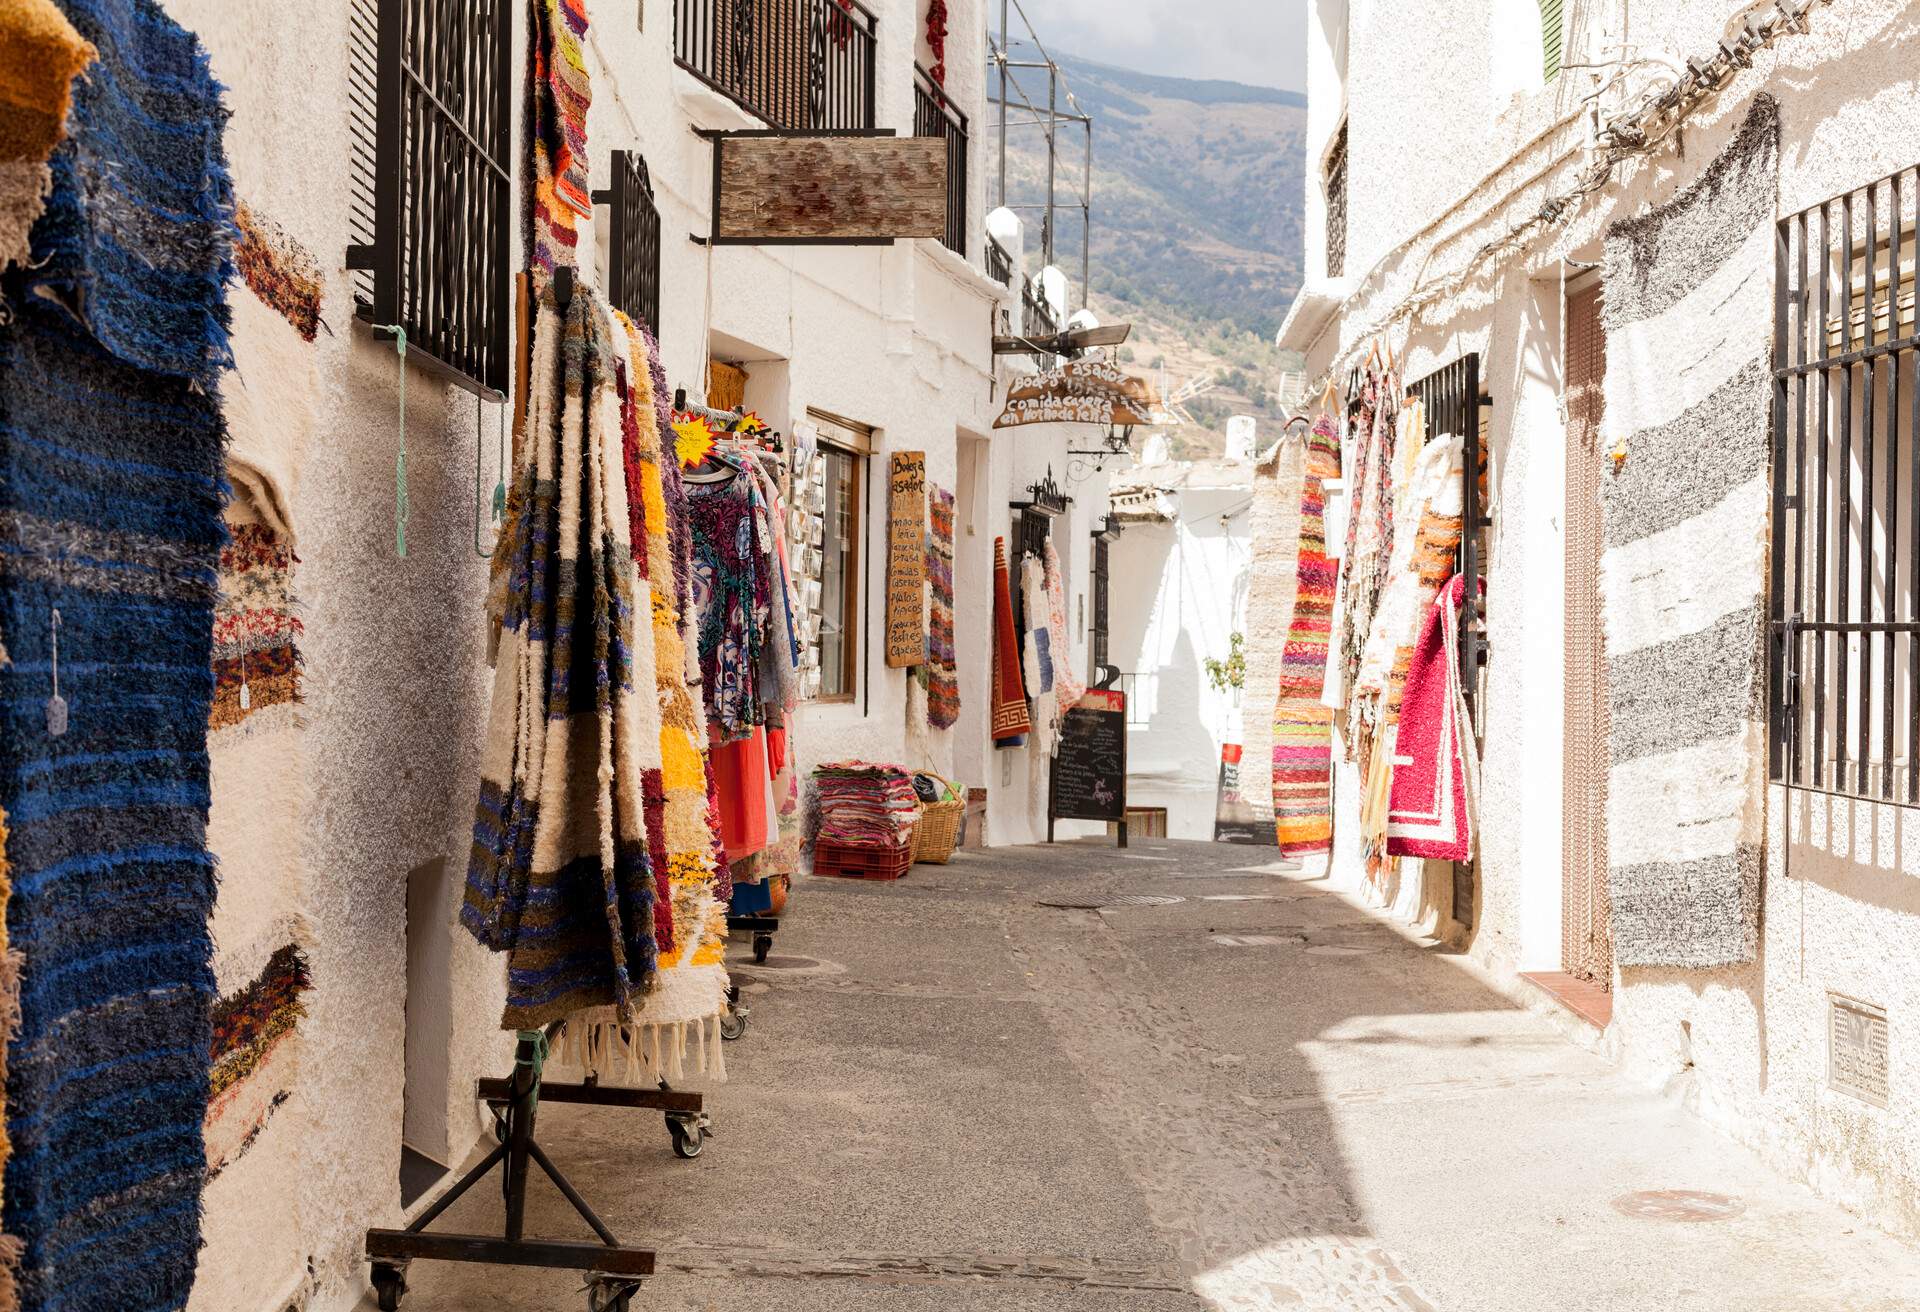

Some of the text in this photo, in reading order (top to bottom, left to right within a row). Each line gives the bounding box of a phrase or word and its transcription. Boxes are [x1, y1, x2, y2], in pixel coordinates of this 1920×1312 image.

[1011, 368, 1066, 393] Bodega
[1000, 412, 1019, 425] en
[893, 454, 925, 479] Bodega
[892, 478, 924, 494] asador
